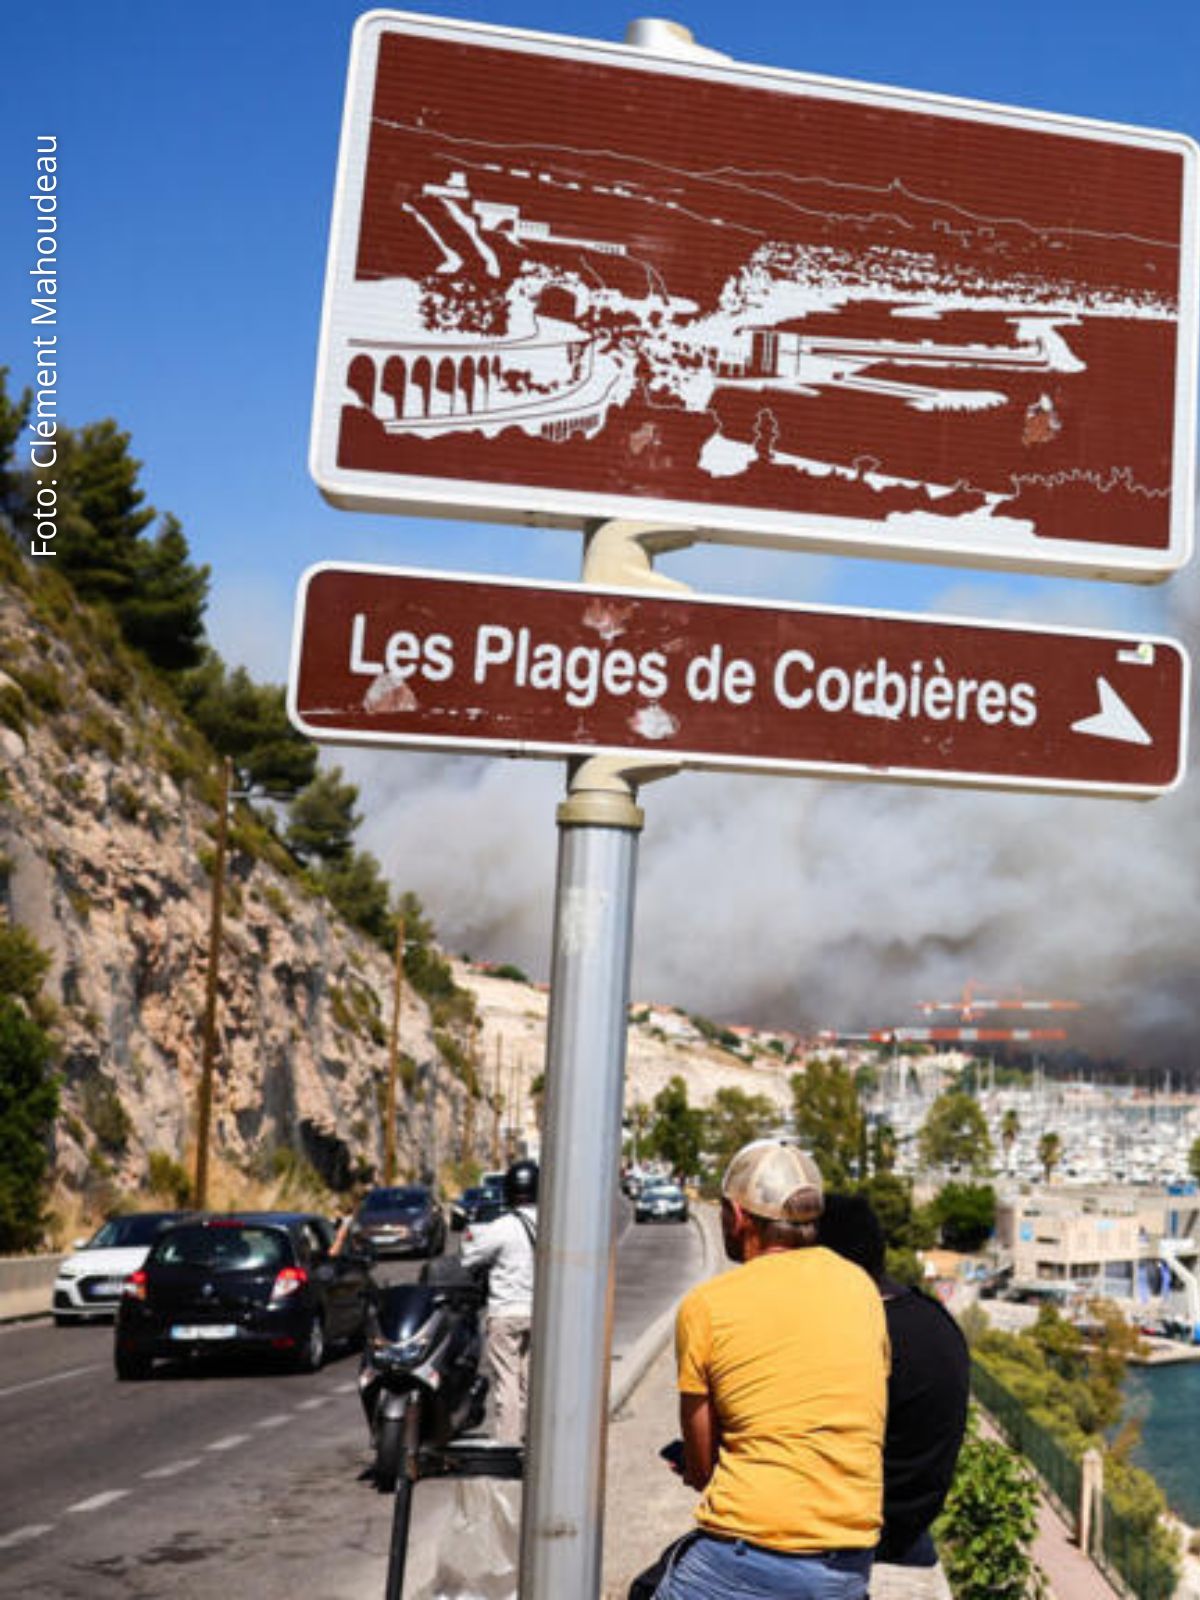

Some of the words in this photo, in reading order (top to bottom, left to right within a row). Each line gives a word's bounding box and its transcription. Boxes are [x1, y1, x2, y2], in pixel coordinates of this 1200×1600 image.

[349, 613, 455, 682] Les
[474, 624, 668, 708] Plages
[686, 643, 756, 704] de
[773, 649, 1038, 727] Corbières
